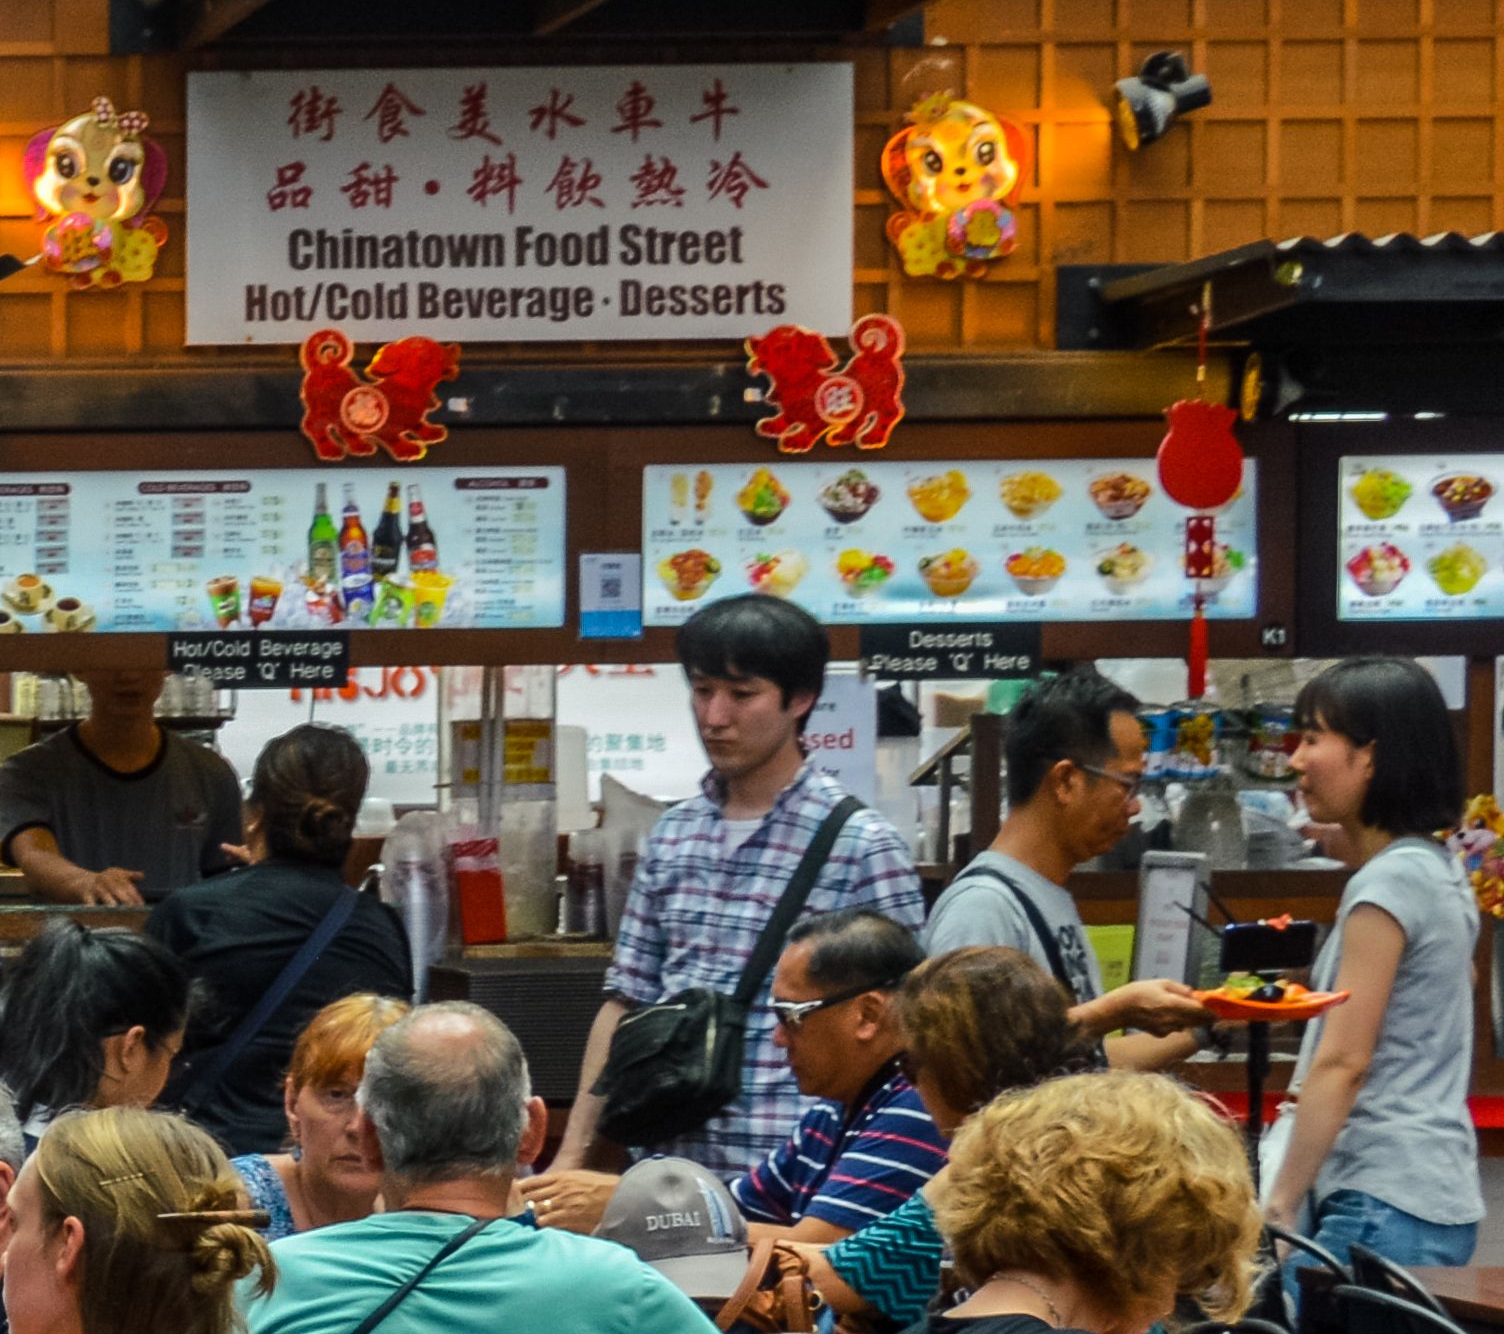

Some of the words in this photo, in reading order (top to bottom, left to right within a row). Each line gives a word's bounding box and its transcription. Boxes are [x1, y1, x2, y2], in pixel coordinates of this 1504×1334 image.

[287, 225, 506, 272] Chinatown
[515, 224, 610, 269] Food
[618, 222, 744, 267] Street
[244, 280, 408, 324] Hot/Cold
[418, 280, 595, 324] Beverage
[619, 278, 787, 318] Desserts
[826, 387, 854, 413] 旺
[909, 630, 993, 649] Desserts
[1261, 628, 1287, 644] K1
[173, 640, 250, 658] Hot/Cold
[260, 640, 343, 659] Beverage
[289, 664, 334, 680] Here
[872, 653, 937, 671] Please
[984, 653, 1031, 671] Here
[800, 729, 855, 751] sed
[646, 1211, 701, 1232] DUBAI
